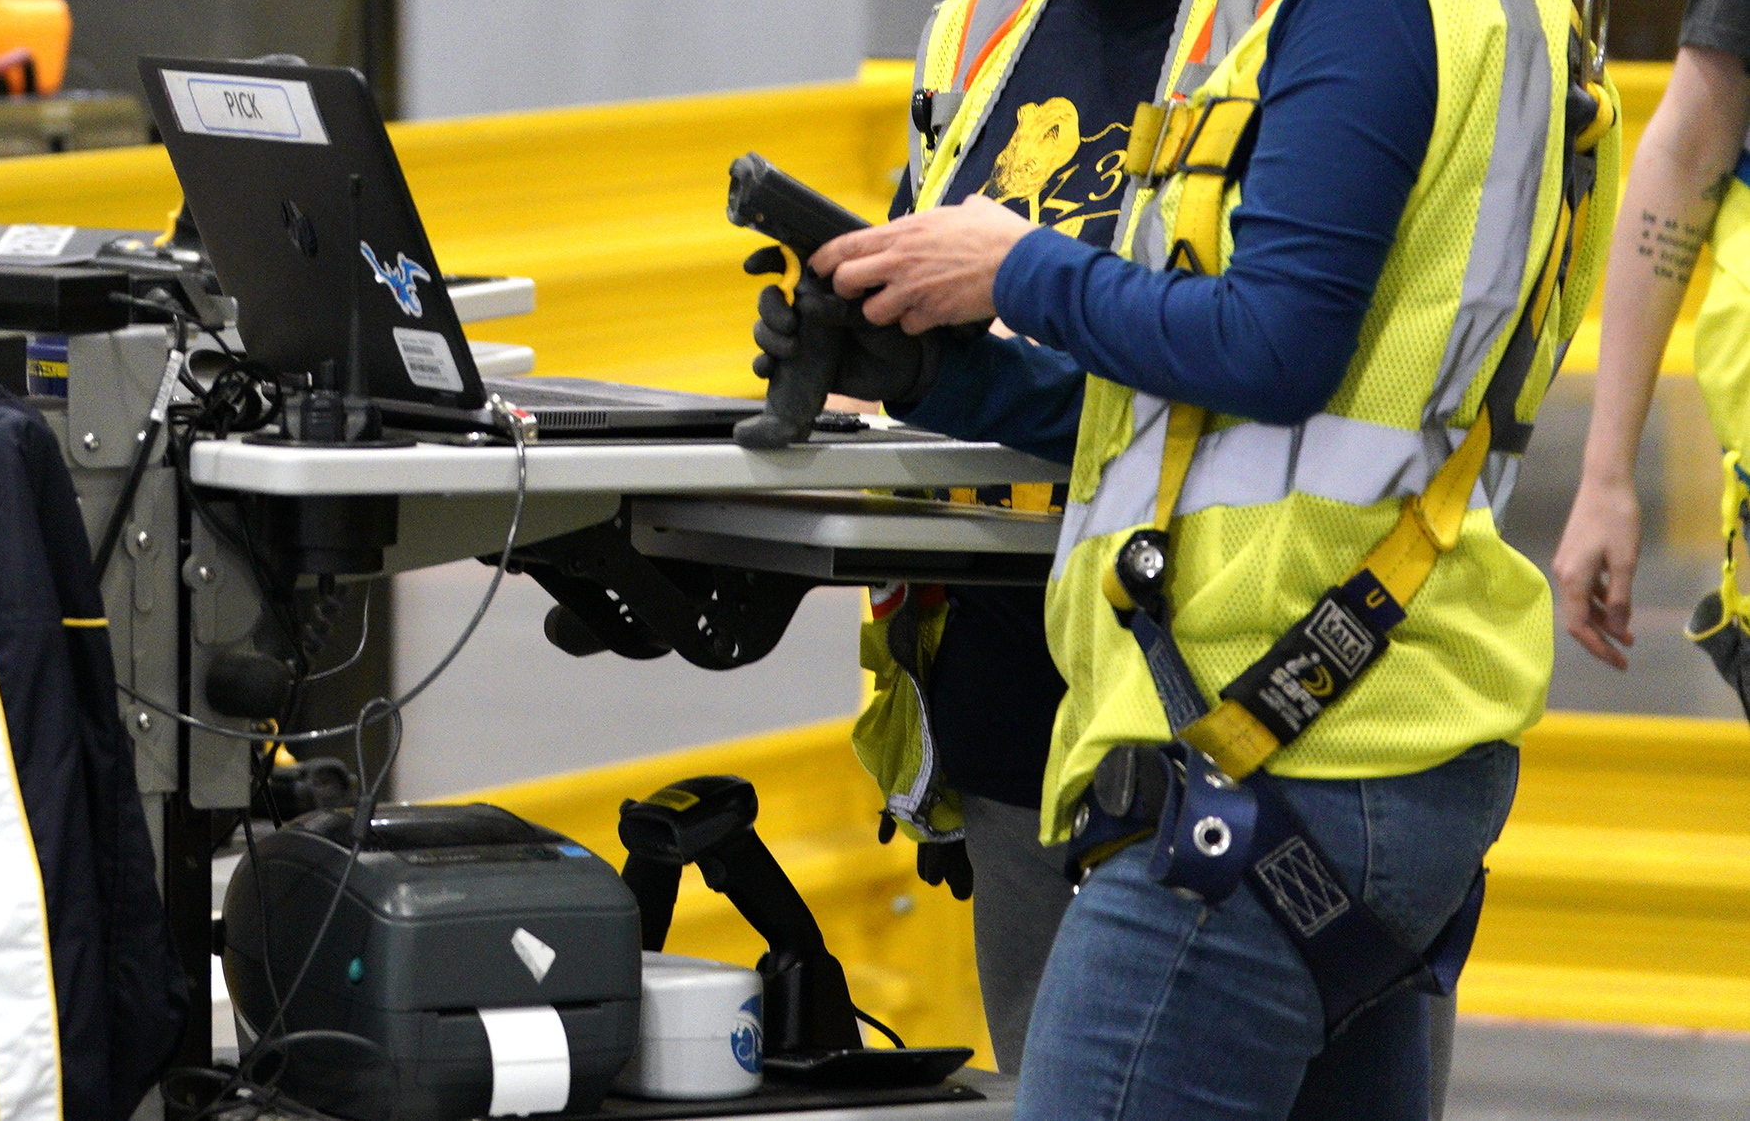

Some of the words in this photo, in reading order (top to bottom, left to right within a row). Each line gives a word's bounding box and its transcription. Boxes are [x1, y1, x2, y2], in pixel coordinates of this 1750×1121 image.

[224, 90, 263, 120] PICK
[1365, 588, 1387, 609] U
[1322, 619, 1359, 662] SALA
